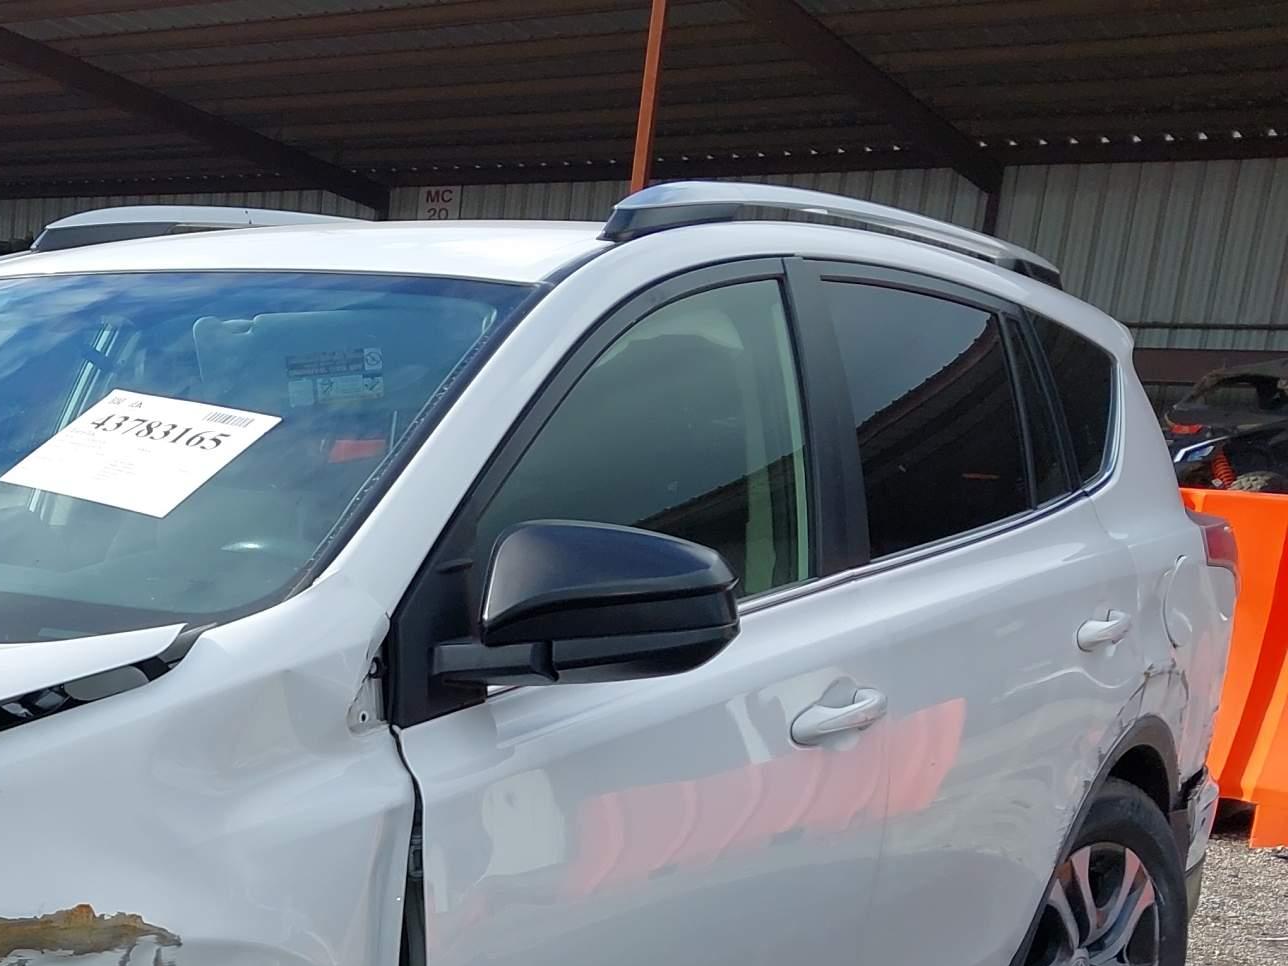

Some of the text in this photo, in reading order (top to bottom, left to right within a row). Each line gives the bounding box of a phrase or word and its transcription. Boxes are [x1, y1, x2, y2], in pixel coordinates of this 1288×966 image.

[426, 190, 453, 203] MC
[426, 207, 449, 220] 20
[90, 414, 232, 450] 43783165
